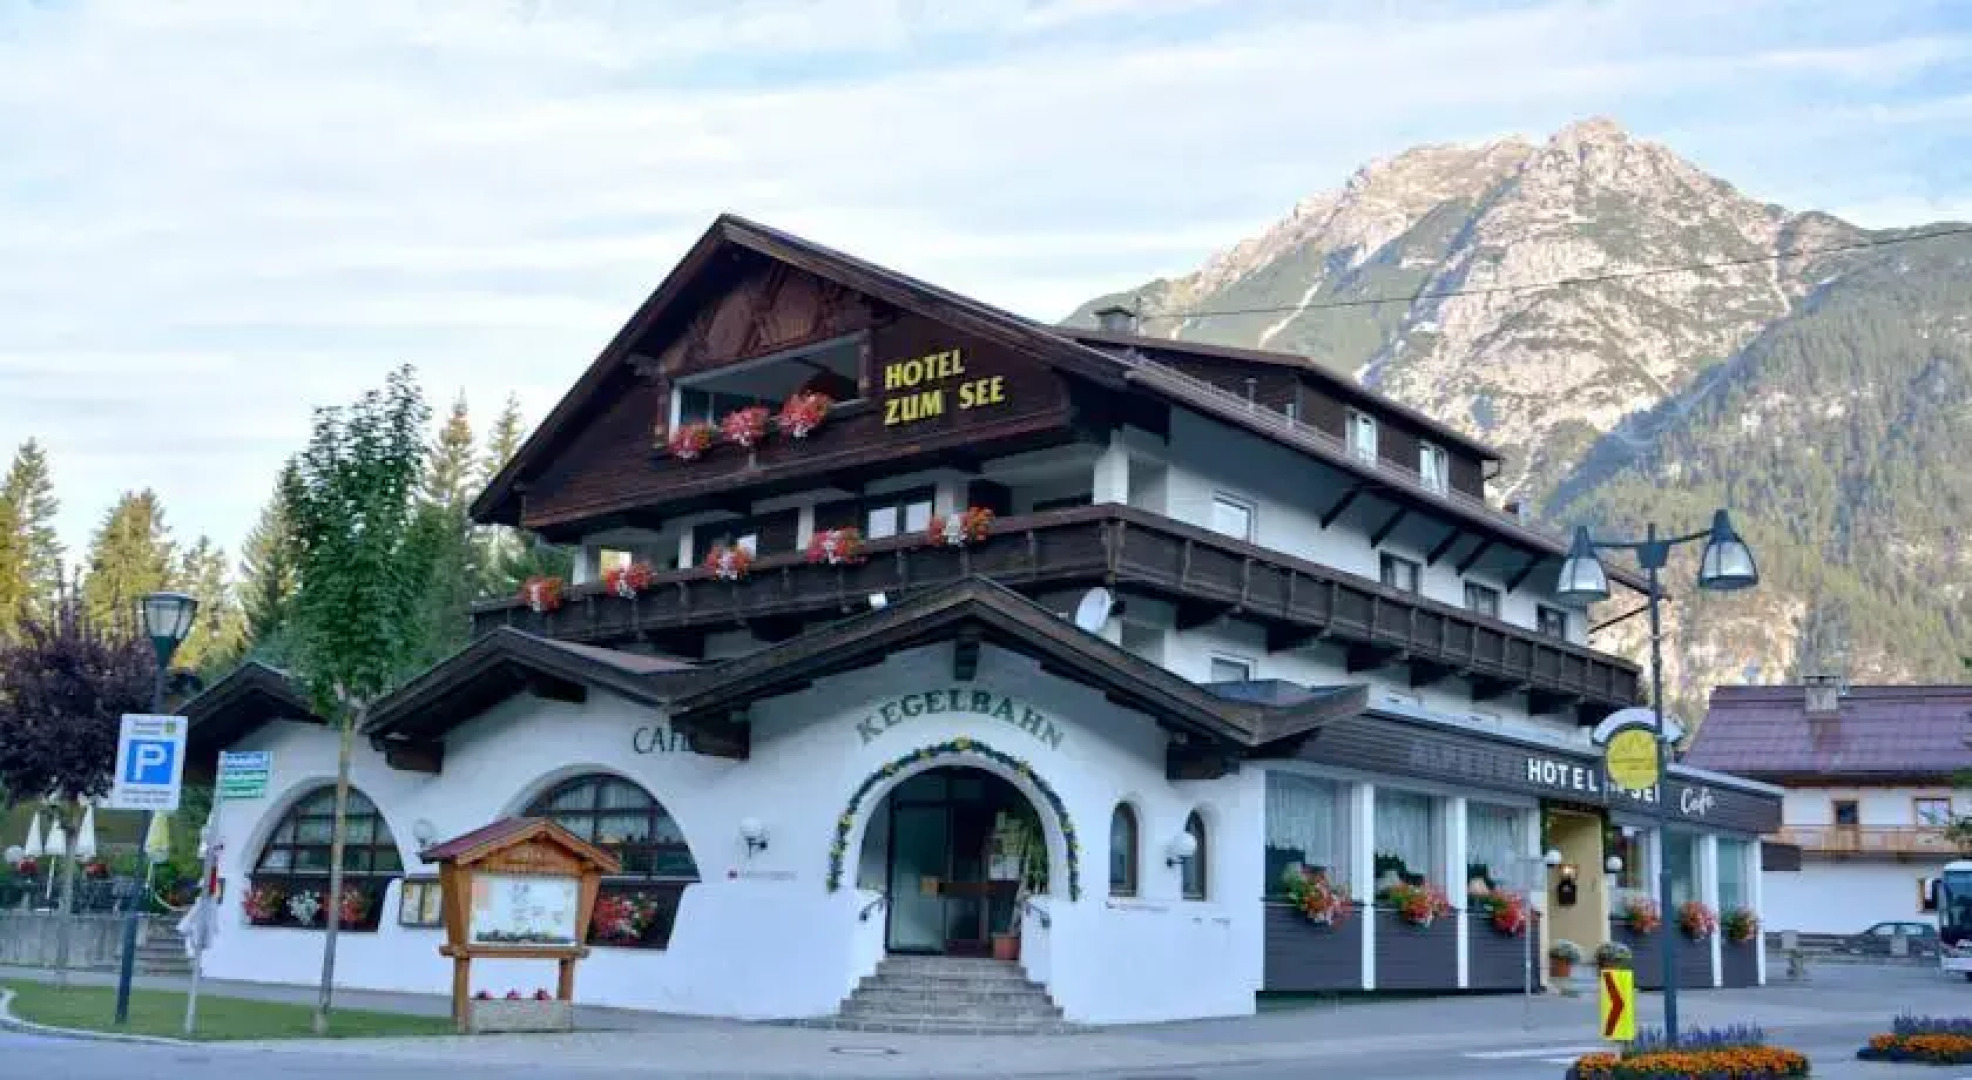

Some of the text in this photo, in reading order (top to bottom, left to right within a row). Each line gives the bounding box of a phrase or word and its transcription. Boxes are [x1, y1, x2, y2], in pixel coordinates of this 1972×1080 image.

[885, 349, 966, 390] HOTEL
[884, 375, 1006, 426] ZUM SEE
[855, 687, 1065, 751] KEGELBAHN
[133, 743, 168, 781] P
[1527, 757, 1598, 792] HOTEL
